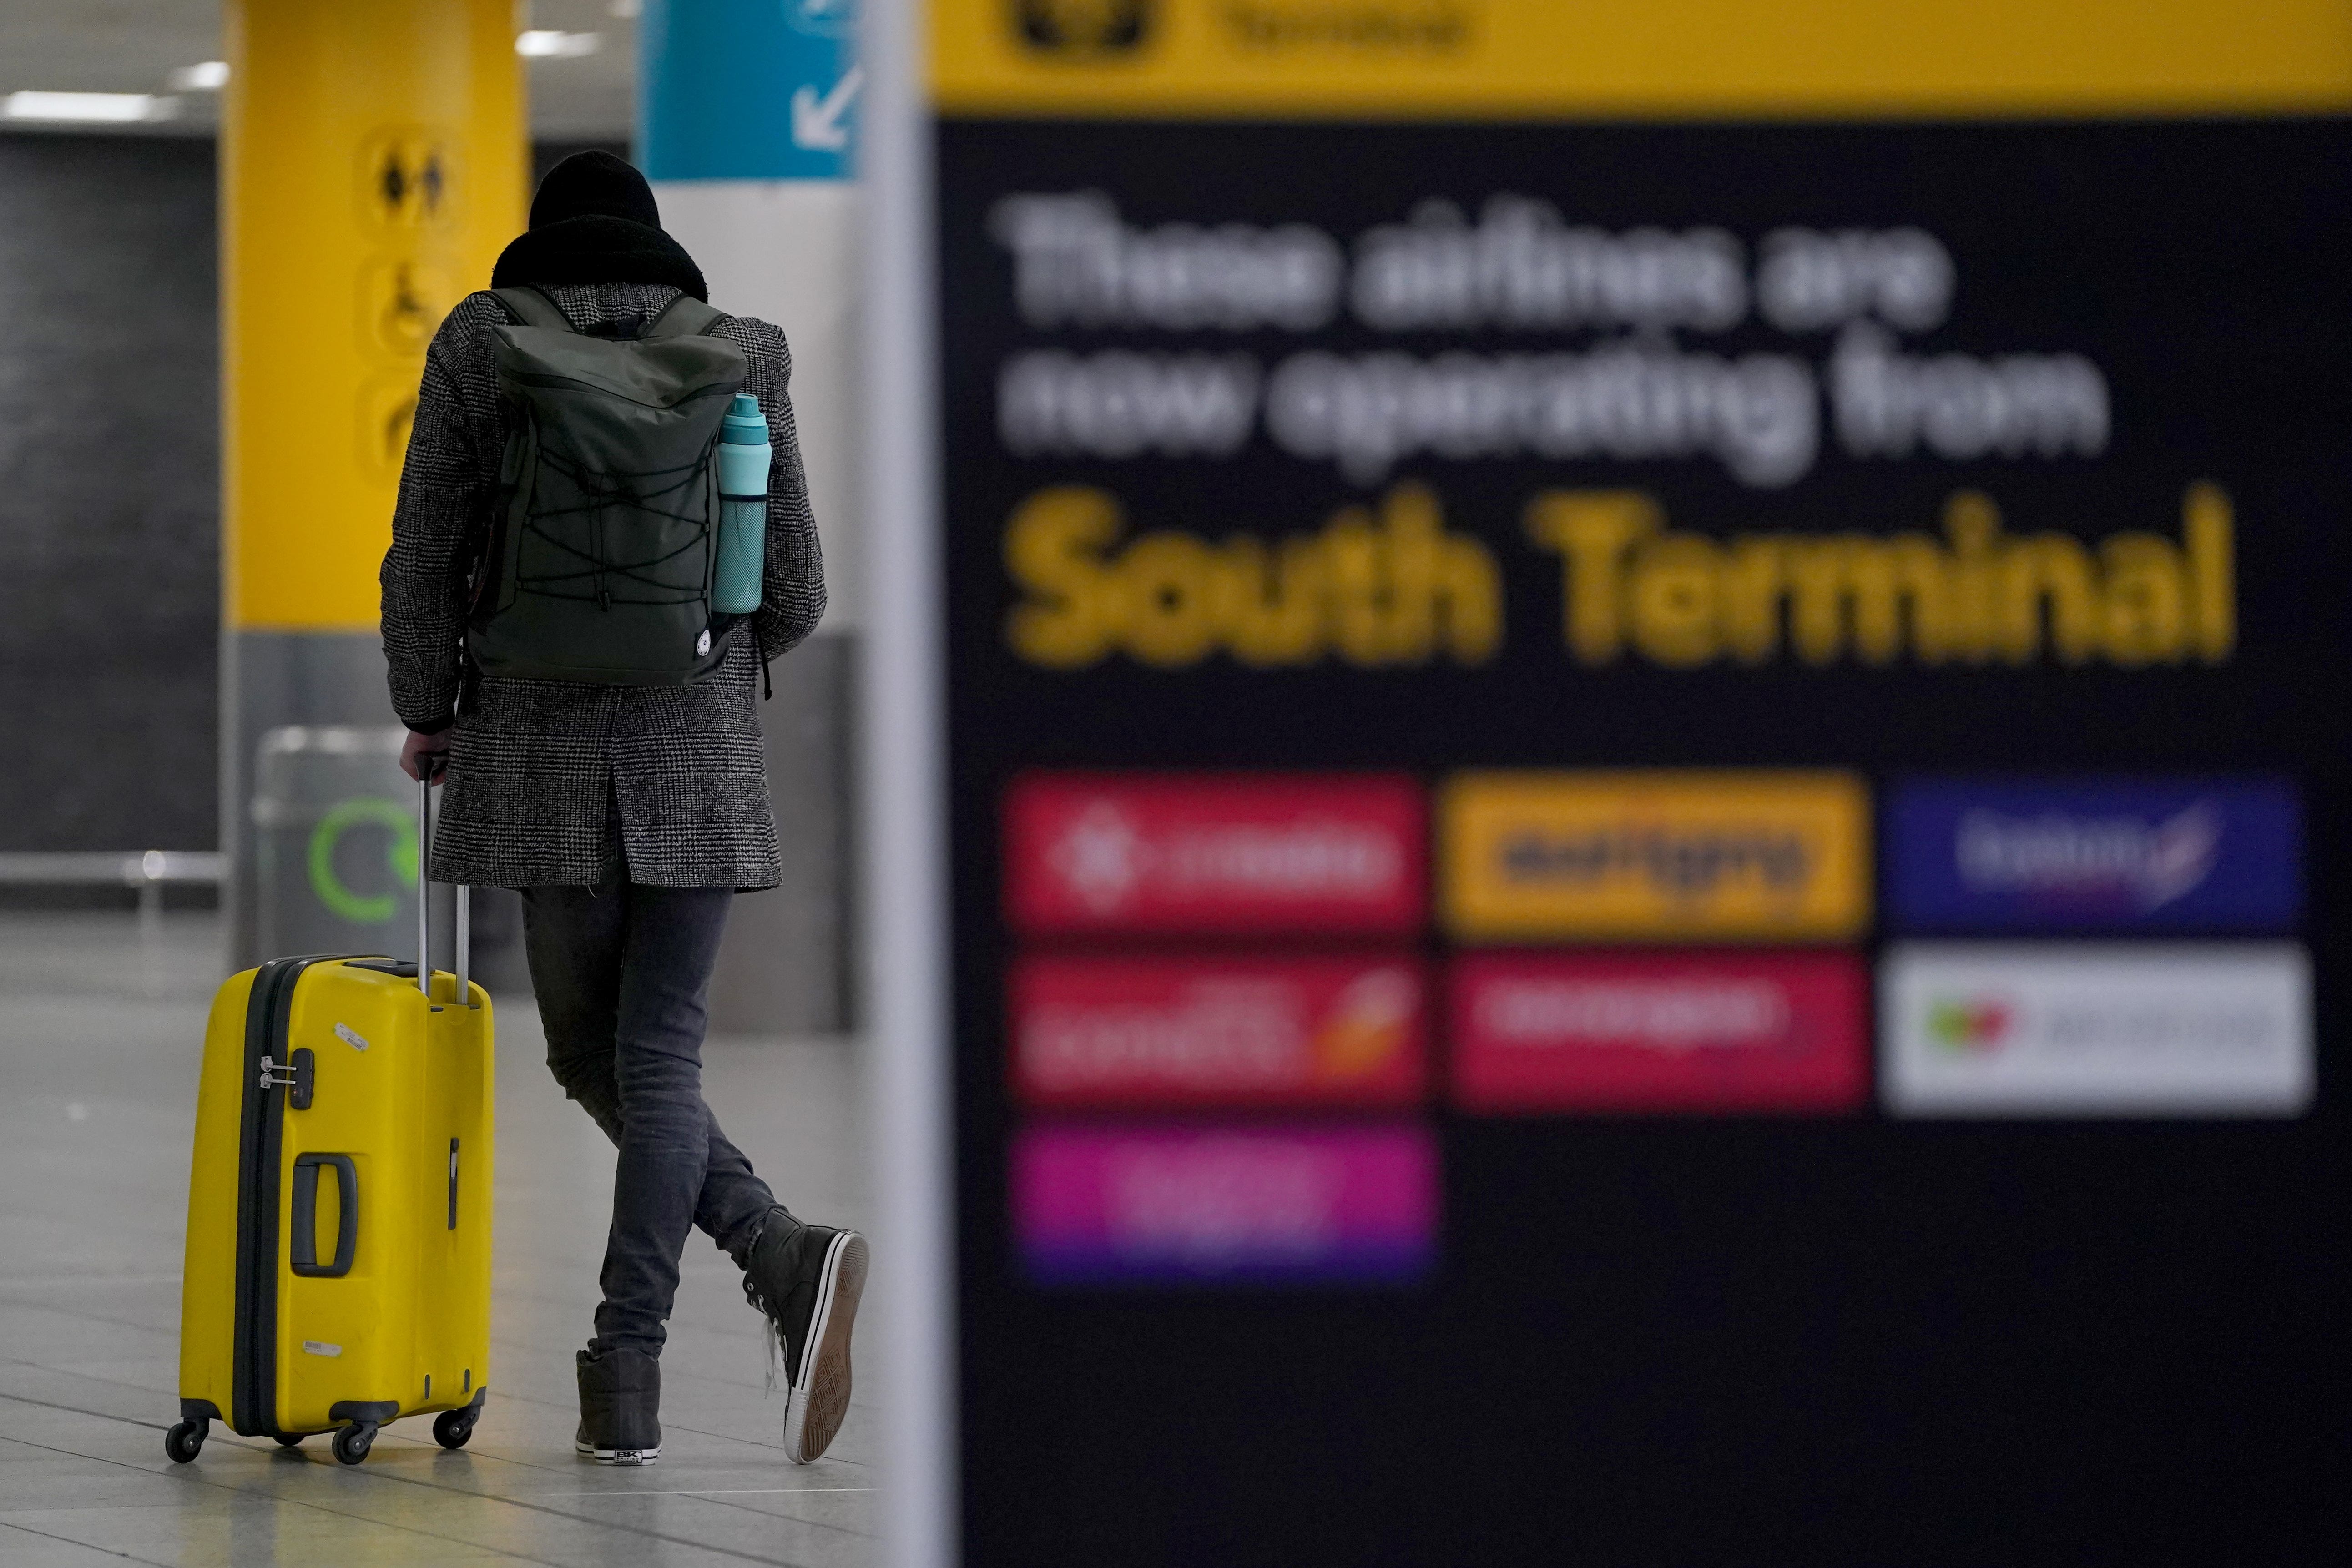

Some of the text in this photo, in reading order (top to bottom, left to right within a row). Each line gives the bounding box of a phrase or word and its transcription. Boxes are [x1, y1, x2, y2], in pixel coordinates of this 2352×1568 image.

[1005, 199, 1948, 326] These airlines are
[1002, 325, 2106, 483] now operating from
[1011, 486, 2231, 660] South Terminal
